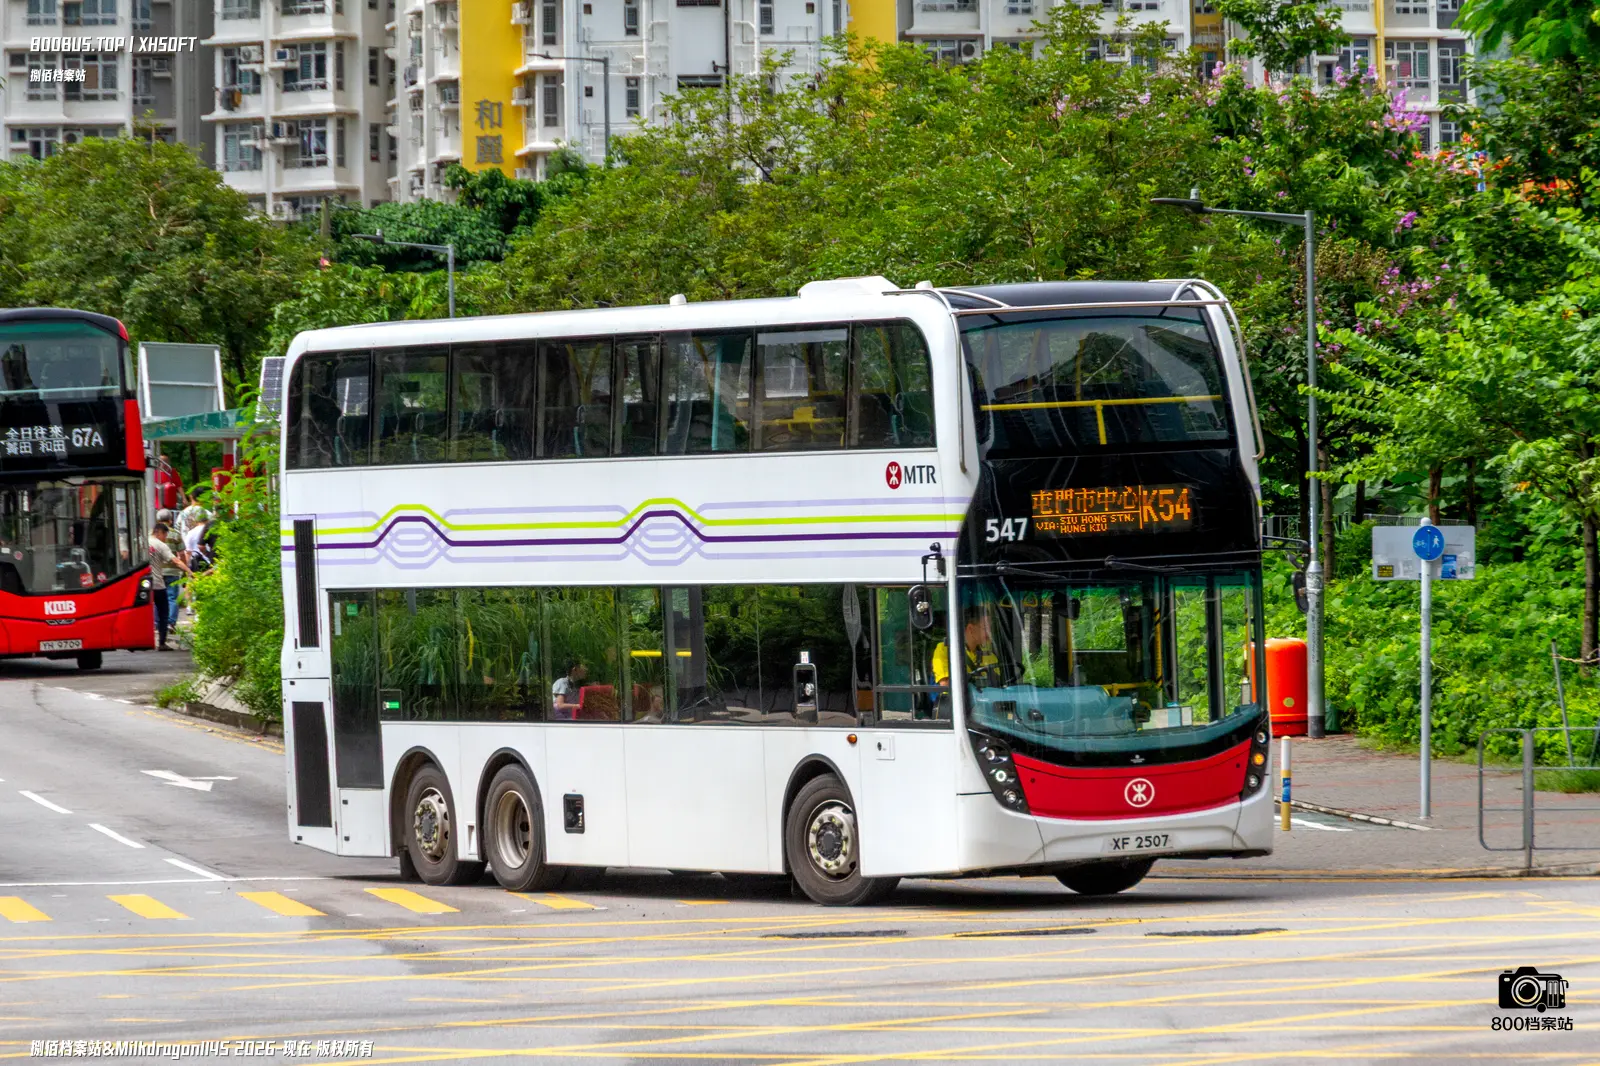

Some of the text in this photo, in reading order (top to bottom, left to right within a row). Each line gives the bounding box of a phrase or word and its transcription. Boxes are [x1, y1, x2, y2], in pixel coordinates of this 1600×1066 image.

[474, 98, 504, 173] 和麗
[5, 425, 63, 440] 全日往來
[71, 427, 104, 447] 67A
[903, 465, 937, 485] MTR
[1031, 485, 1138, 515] 屯門市中心
[1142, 487, 1192, 523] K54
[985, 517, 1028, 542] 547
[1036, 521, 1060, 531] VIA:
[1060, 516, 1079, 525] SIU
[1081, 514, 1107, 524] HONG
[1060, 523, 1108, 534] HUNG KIU
[44, 600, 76, 615] KMB
[1112, 834, 1169, 851] XF 2507
